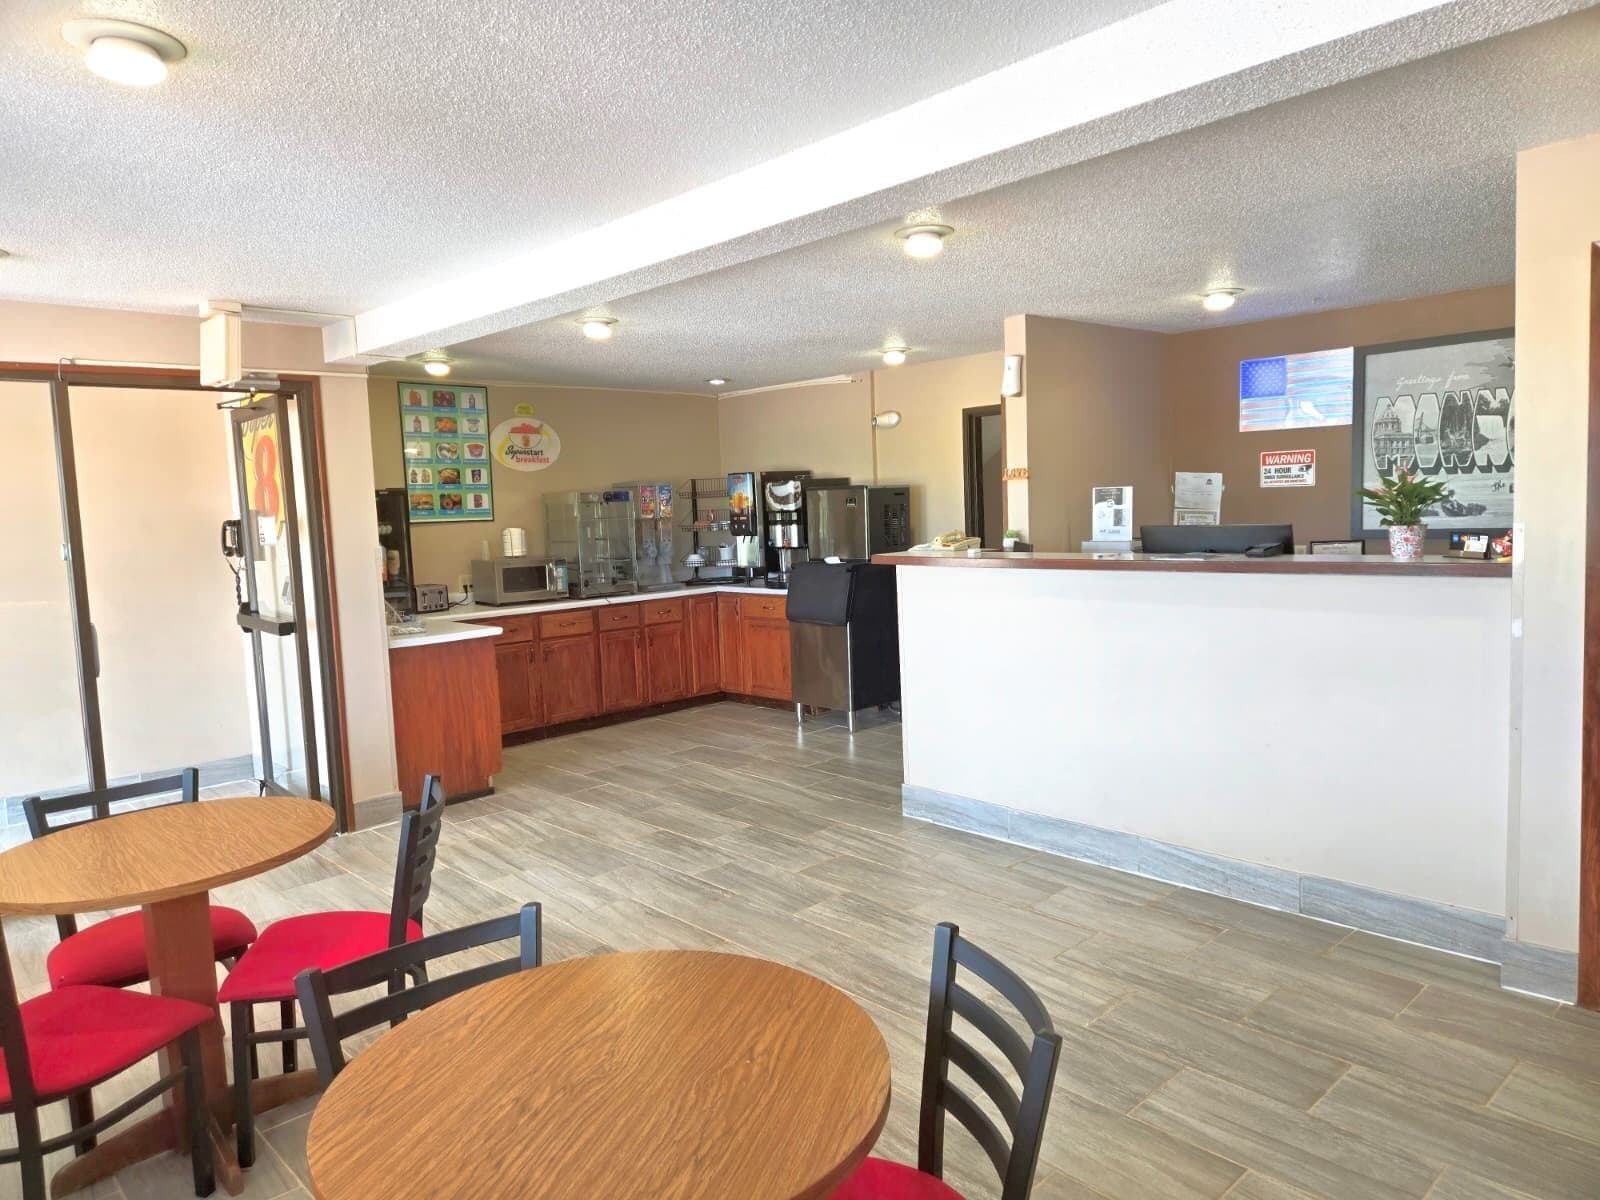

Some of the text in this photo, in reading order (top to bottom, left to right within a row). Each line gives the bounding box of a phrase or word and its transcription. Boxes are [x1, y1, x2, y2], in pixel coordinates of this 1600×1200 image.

[1395, 370, 1470, 392] Greetings from
[1372, 388, 1514, 475] MINN
[515, 456, 550, 464] breakfast
[1265, 454, 1311, 464] WARNING
[254, 435, 280, 519] 8
